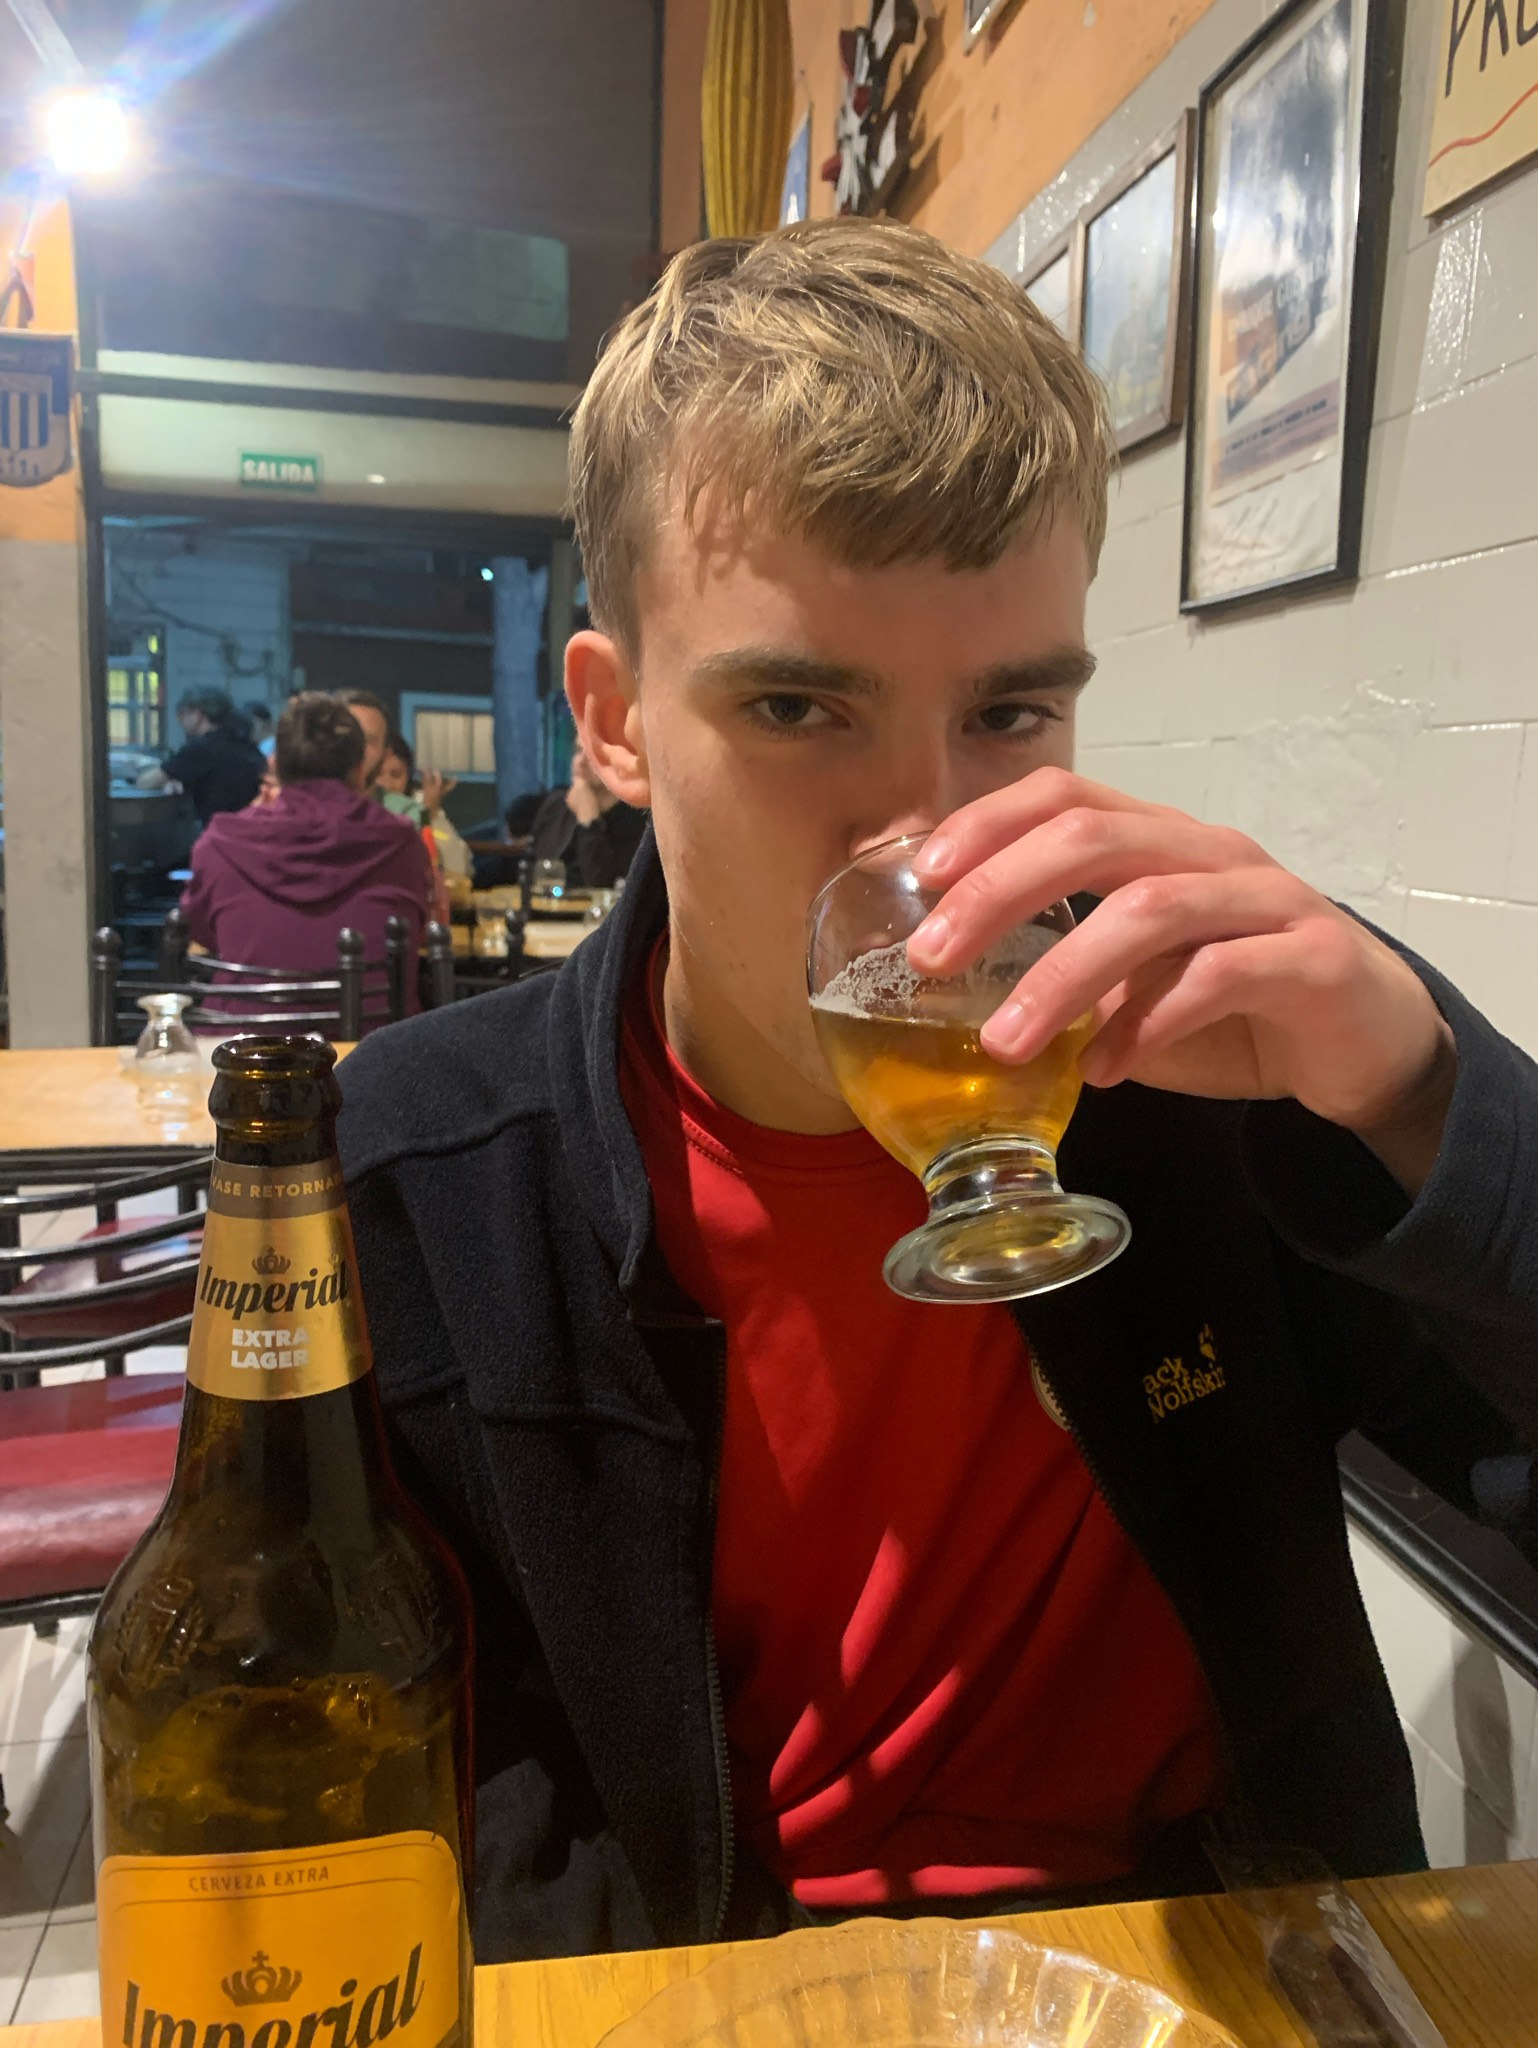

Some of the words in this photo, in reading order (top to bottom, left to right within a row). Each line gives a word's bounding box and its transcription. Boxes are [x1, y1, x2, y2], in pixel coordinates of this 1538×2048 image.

[243, 459, 315, 482] SALIDA
[200, 1260, 349, 1321] Imperial
[231, 1327, 309, 1348] EXTRA
[230, 1350, 308, 1370] LAGER
[189, 1873, 266, 1892] CERVEZA
[273, 1865, 329, 1887] EXTRA
